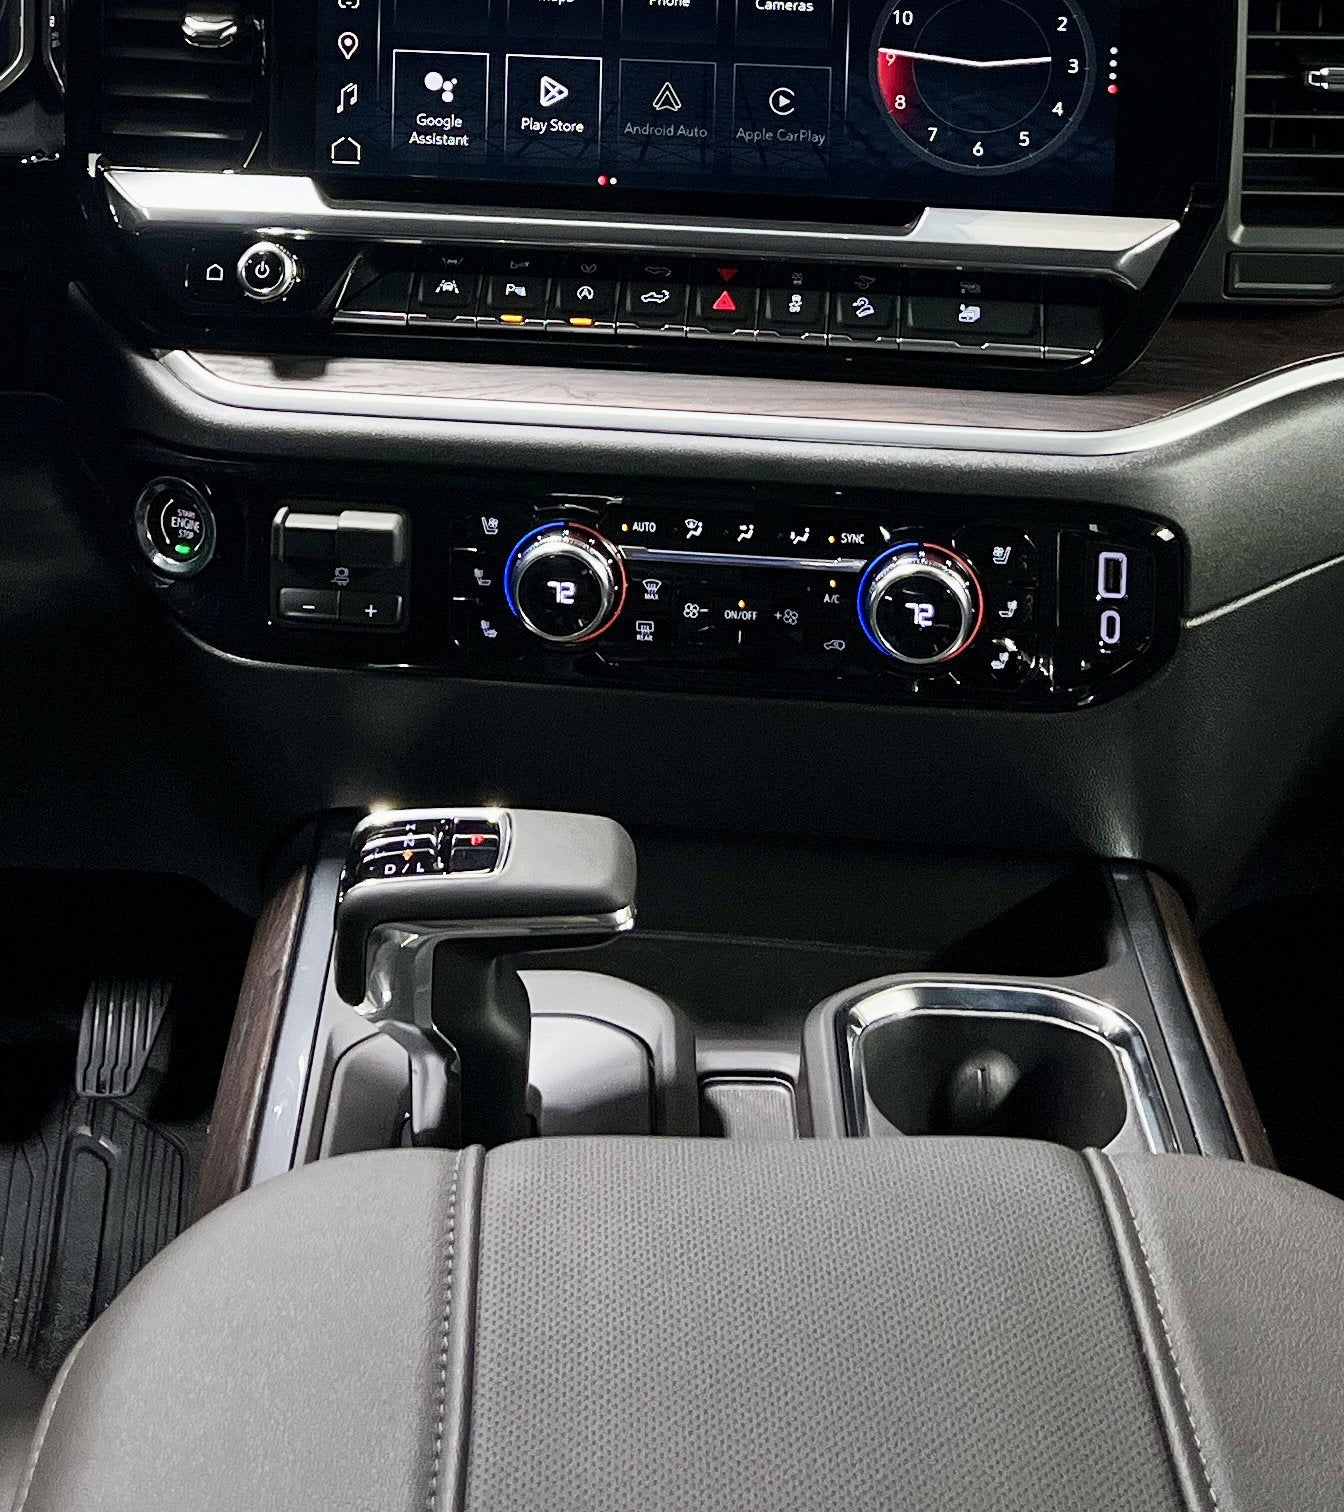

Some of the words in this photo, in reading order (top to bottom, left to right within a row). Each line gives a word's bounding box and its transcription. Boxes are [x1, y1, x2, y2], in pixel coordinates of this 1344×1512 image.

[893, 10, 913, 25] 10
[1057, 17, 1067, 31] 2
[1068, 59, 1078, 73] 3
[894, 94, 906, 111] 8
[1052, 102, 1063, 116] 4
[417, 113, 462, 130] Google
[521, 117, 547, 134] Play
[551, 119, 584, 132] Store
[624, 123, 679, 136] Android
[681, 125, 707, 137] Auto
[736, 128, 772, 142] Apple
[777, 129, 825, 146] CarPlay
[928, 127, 937, 141] 7
[409, 132, 469, 146] Assistant
[1019, 131, 1029, 146] 5
[973, 142, 983, 156] 6
[177, 509, 196, 519] START
[171, 517, 200, 533] ENGINE
[633, 522, 656, 532] AUTO
[178, 529, 194, 539] STOP
[841, 533, 864, 544] SYNC
[547, 581, 575, 604] 72
[824, 594, 839, 603] A/C
[725, 610, 757, 620] ON/OFF
[905, 603, 934, 627] 72
